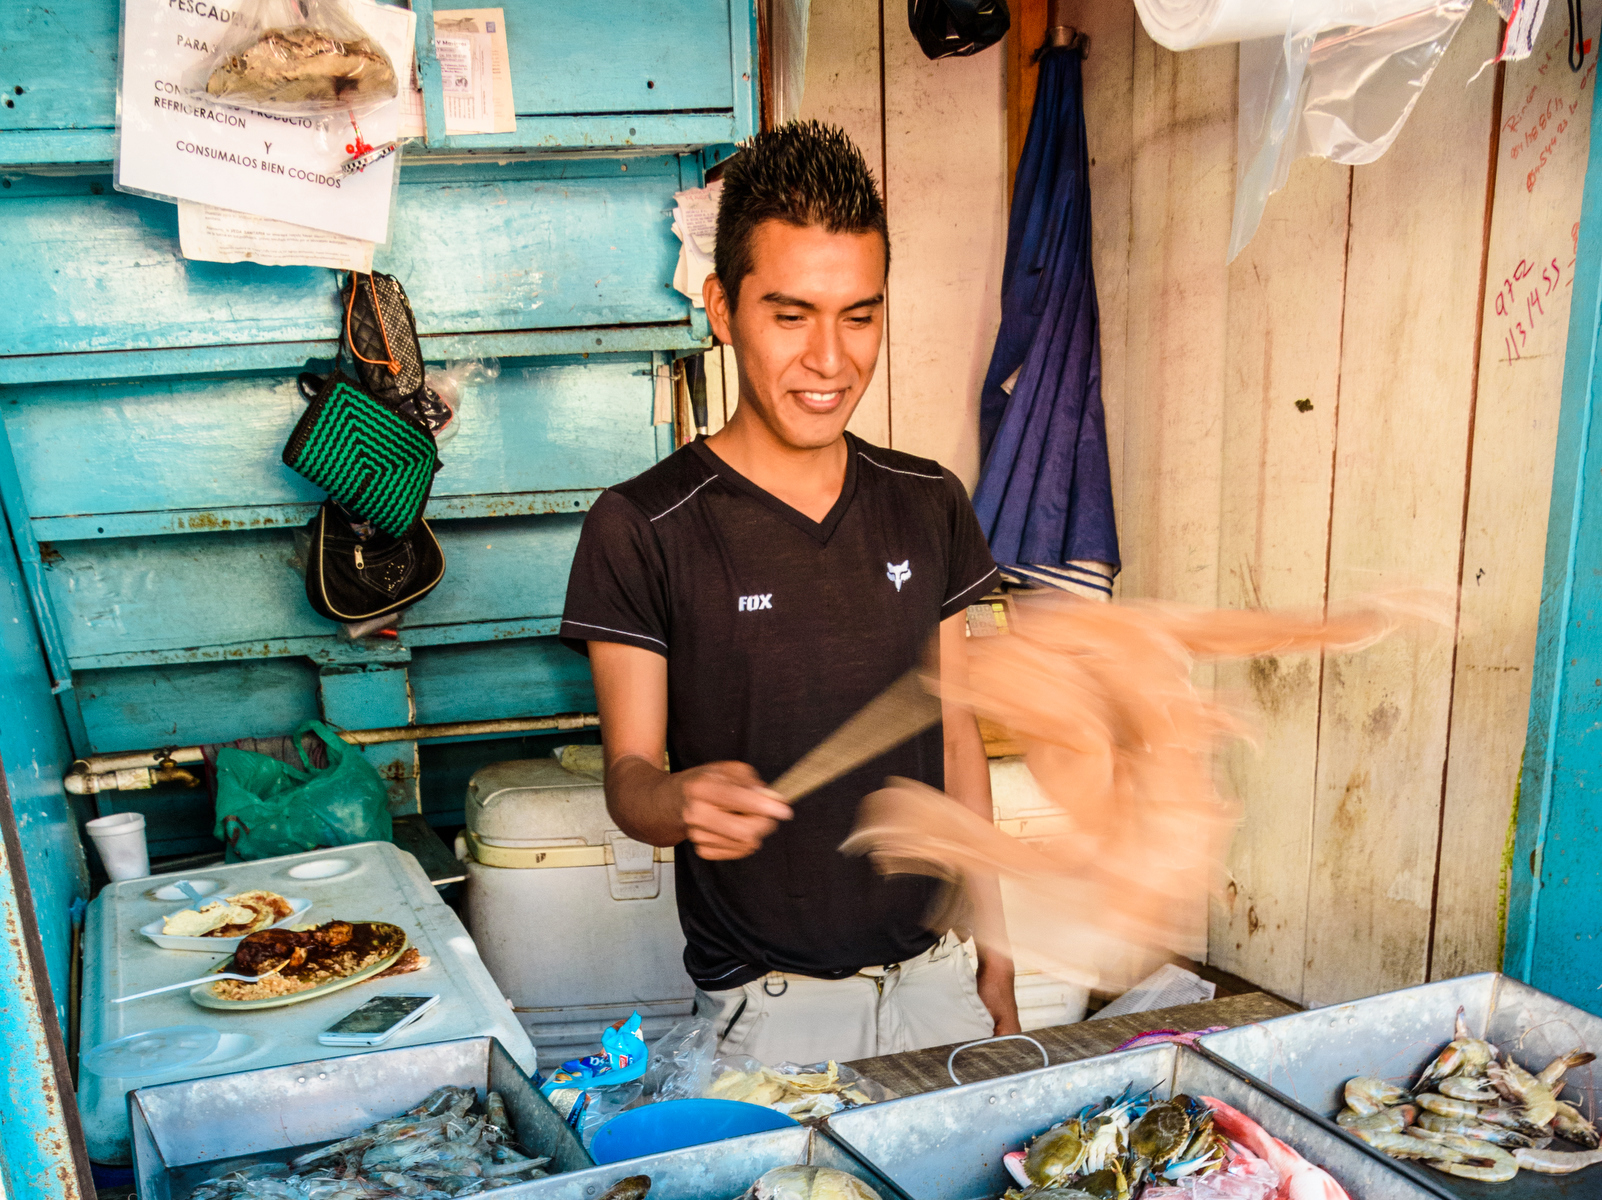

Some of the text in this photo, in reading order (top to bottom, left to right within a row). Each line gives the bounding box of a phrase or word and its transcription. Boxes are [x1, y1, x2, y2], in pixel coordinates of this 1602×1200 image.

[176, 34, 208, 53] PARA
[154, 96, 246, 129] REFRIGERACION
[264, 141, 272, 154] Y
[176, 140, 341, 189] CONSUMALOS BIEN COCIDOS
[738, 593, 773, 612] FOX
